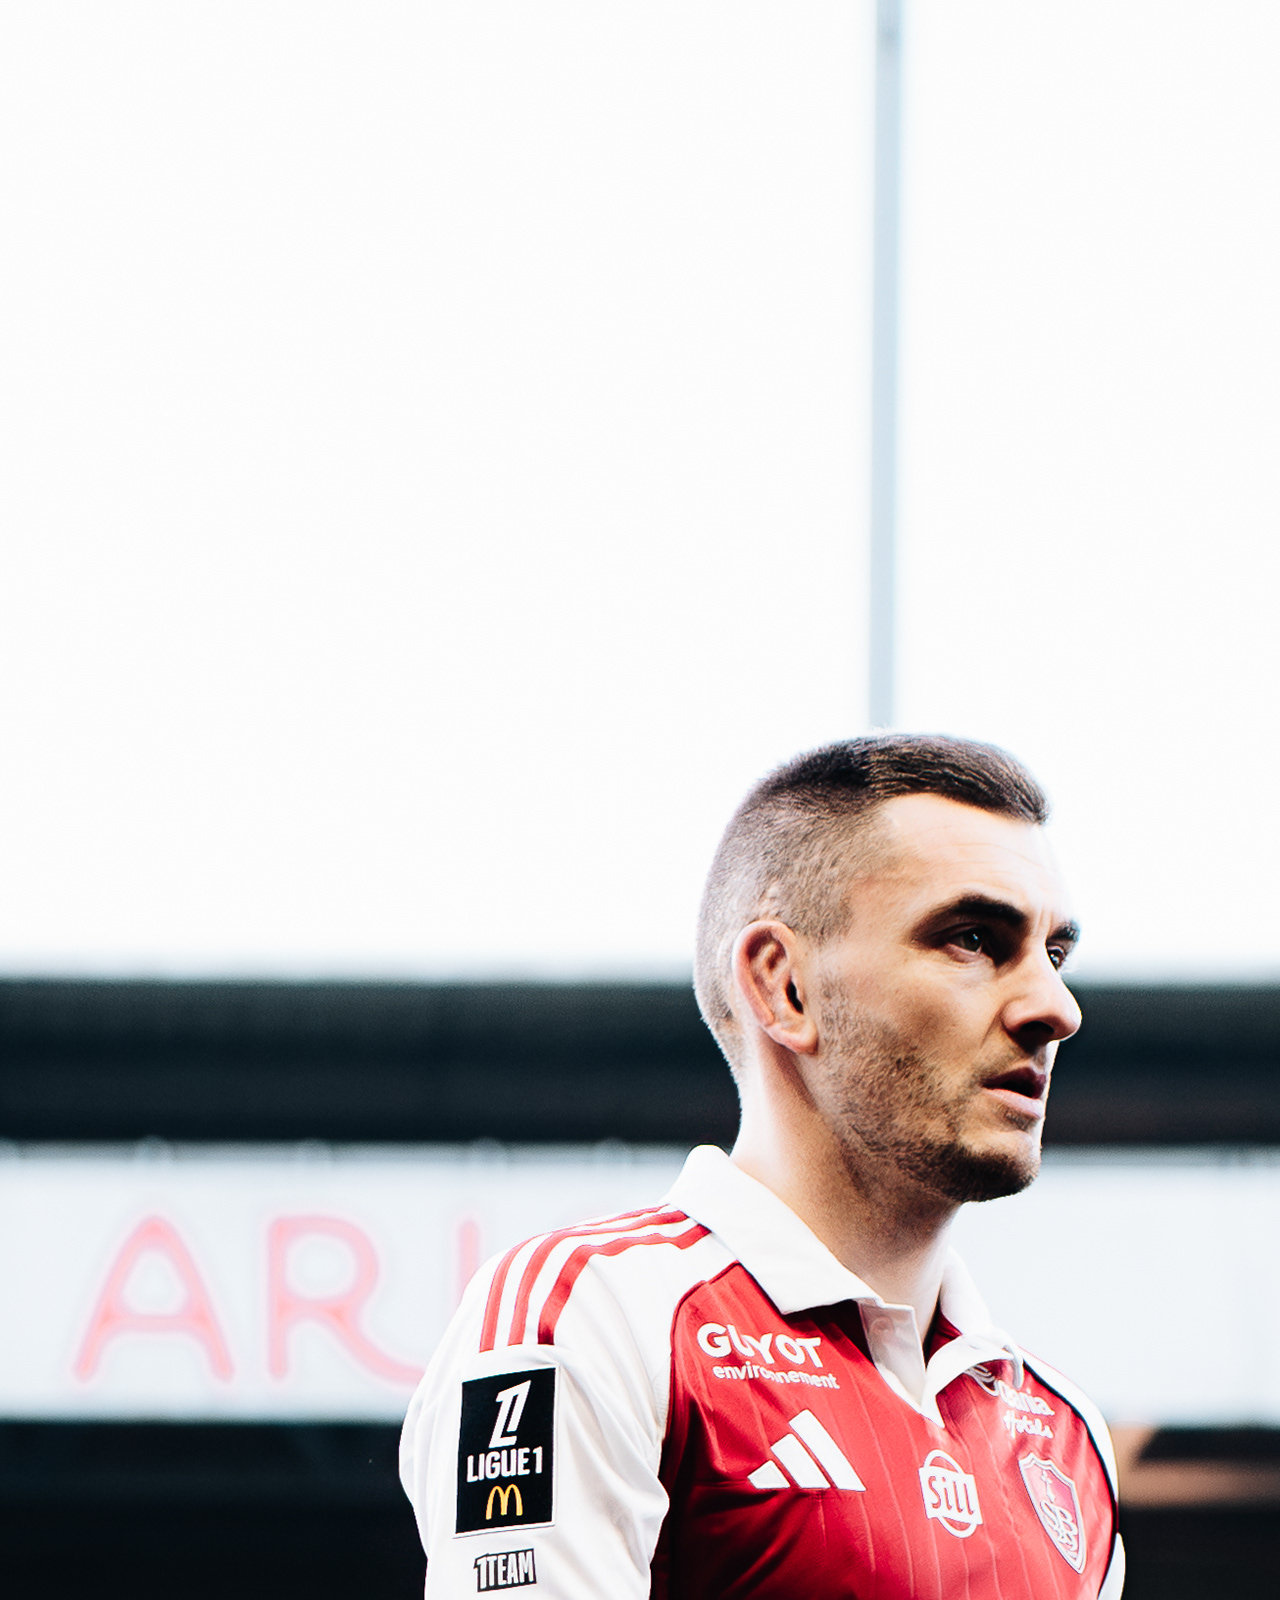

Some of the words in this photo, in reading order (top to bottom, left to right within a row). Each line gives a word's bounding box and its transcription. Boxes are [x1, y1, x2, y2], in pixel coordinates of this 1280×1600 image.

[466, 1447, 530, 1483] LIGUE
[532, 1446, 543, 1474] 1
[476, 1550, 535, 1590] 1TEAM
